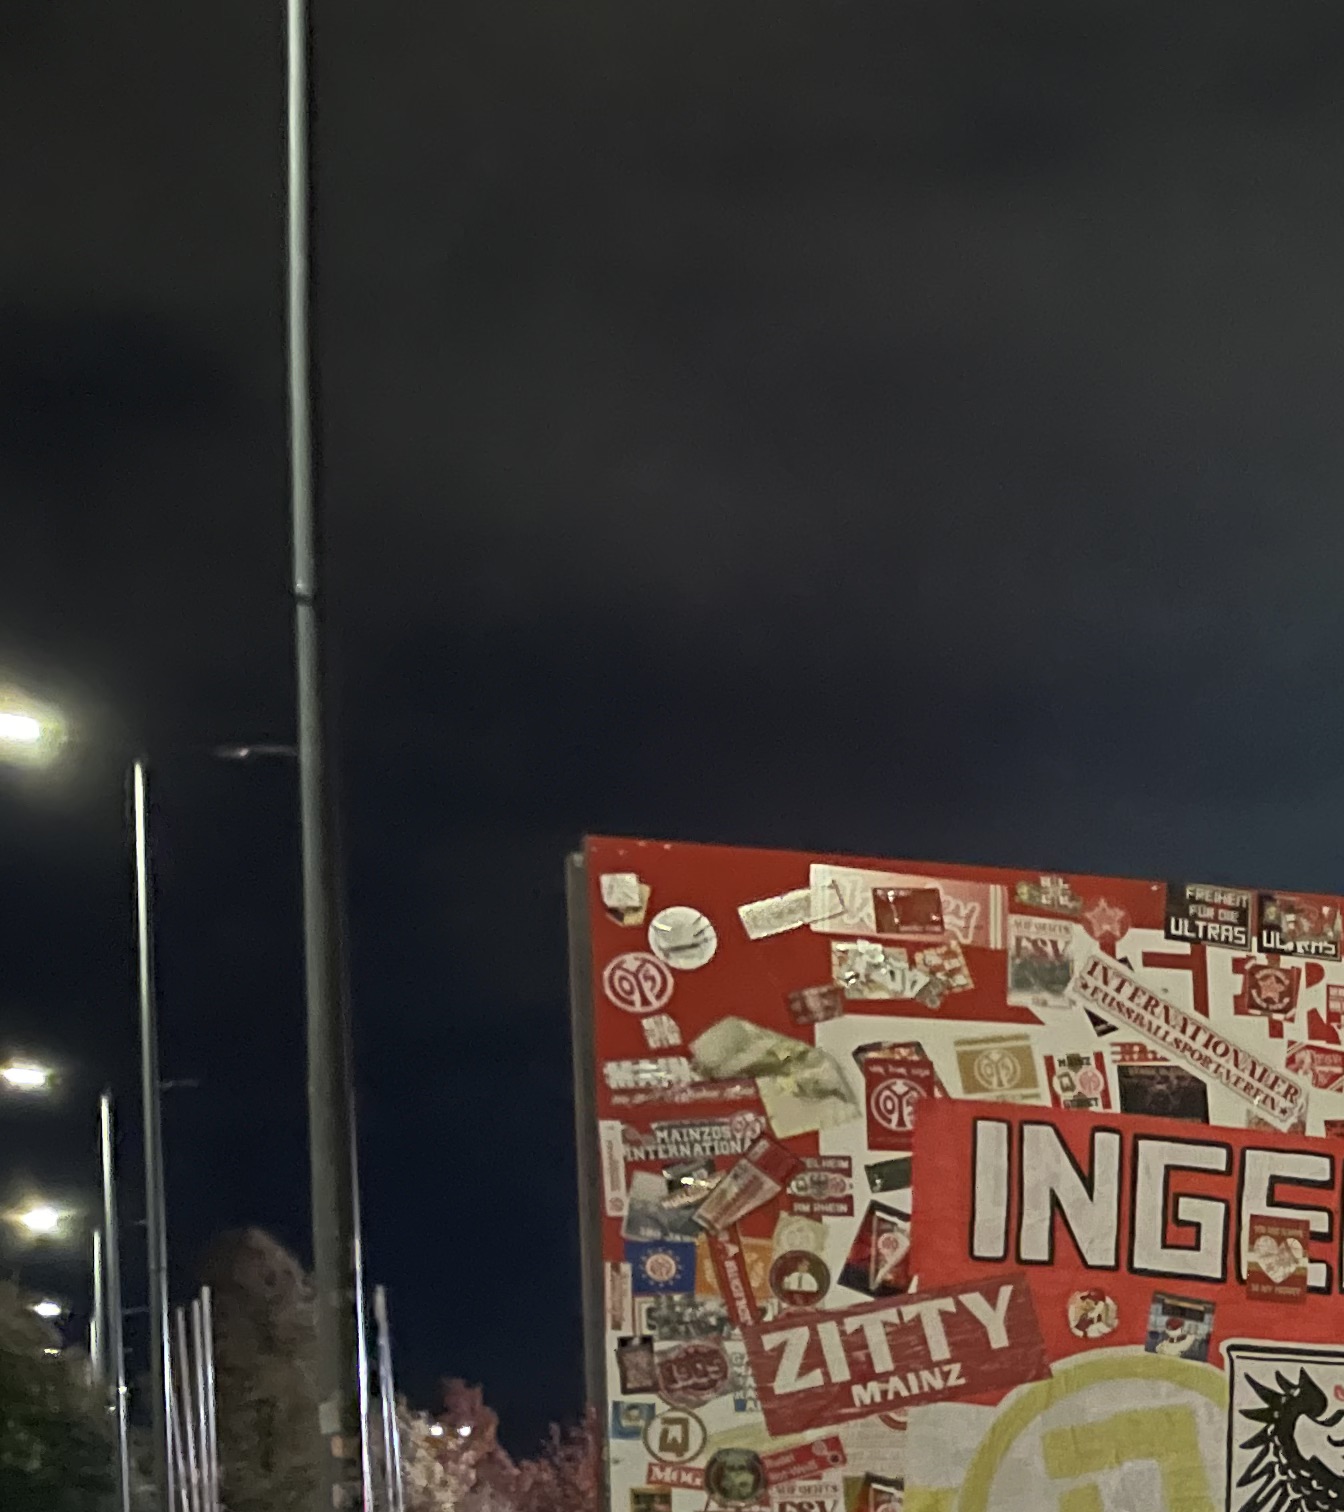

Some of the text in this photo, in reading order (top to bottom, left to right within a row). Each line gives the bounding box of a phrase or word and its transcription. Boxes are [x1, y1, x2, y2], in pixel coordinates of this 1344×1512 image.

[1186, 886, 1248, 907] FREIHEIT
[1170, 917, 1246, 945] ULTRAS
[1262, 930, 1336, 955] ULRAS
[1086, 957, 1301, 1106] INTERNATIONALER
[764, 1283, 1016, 1394] ZITTY
[851, 1362, 967, 1408] MAINZ
